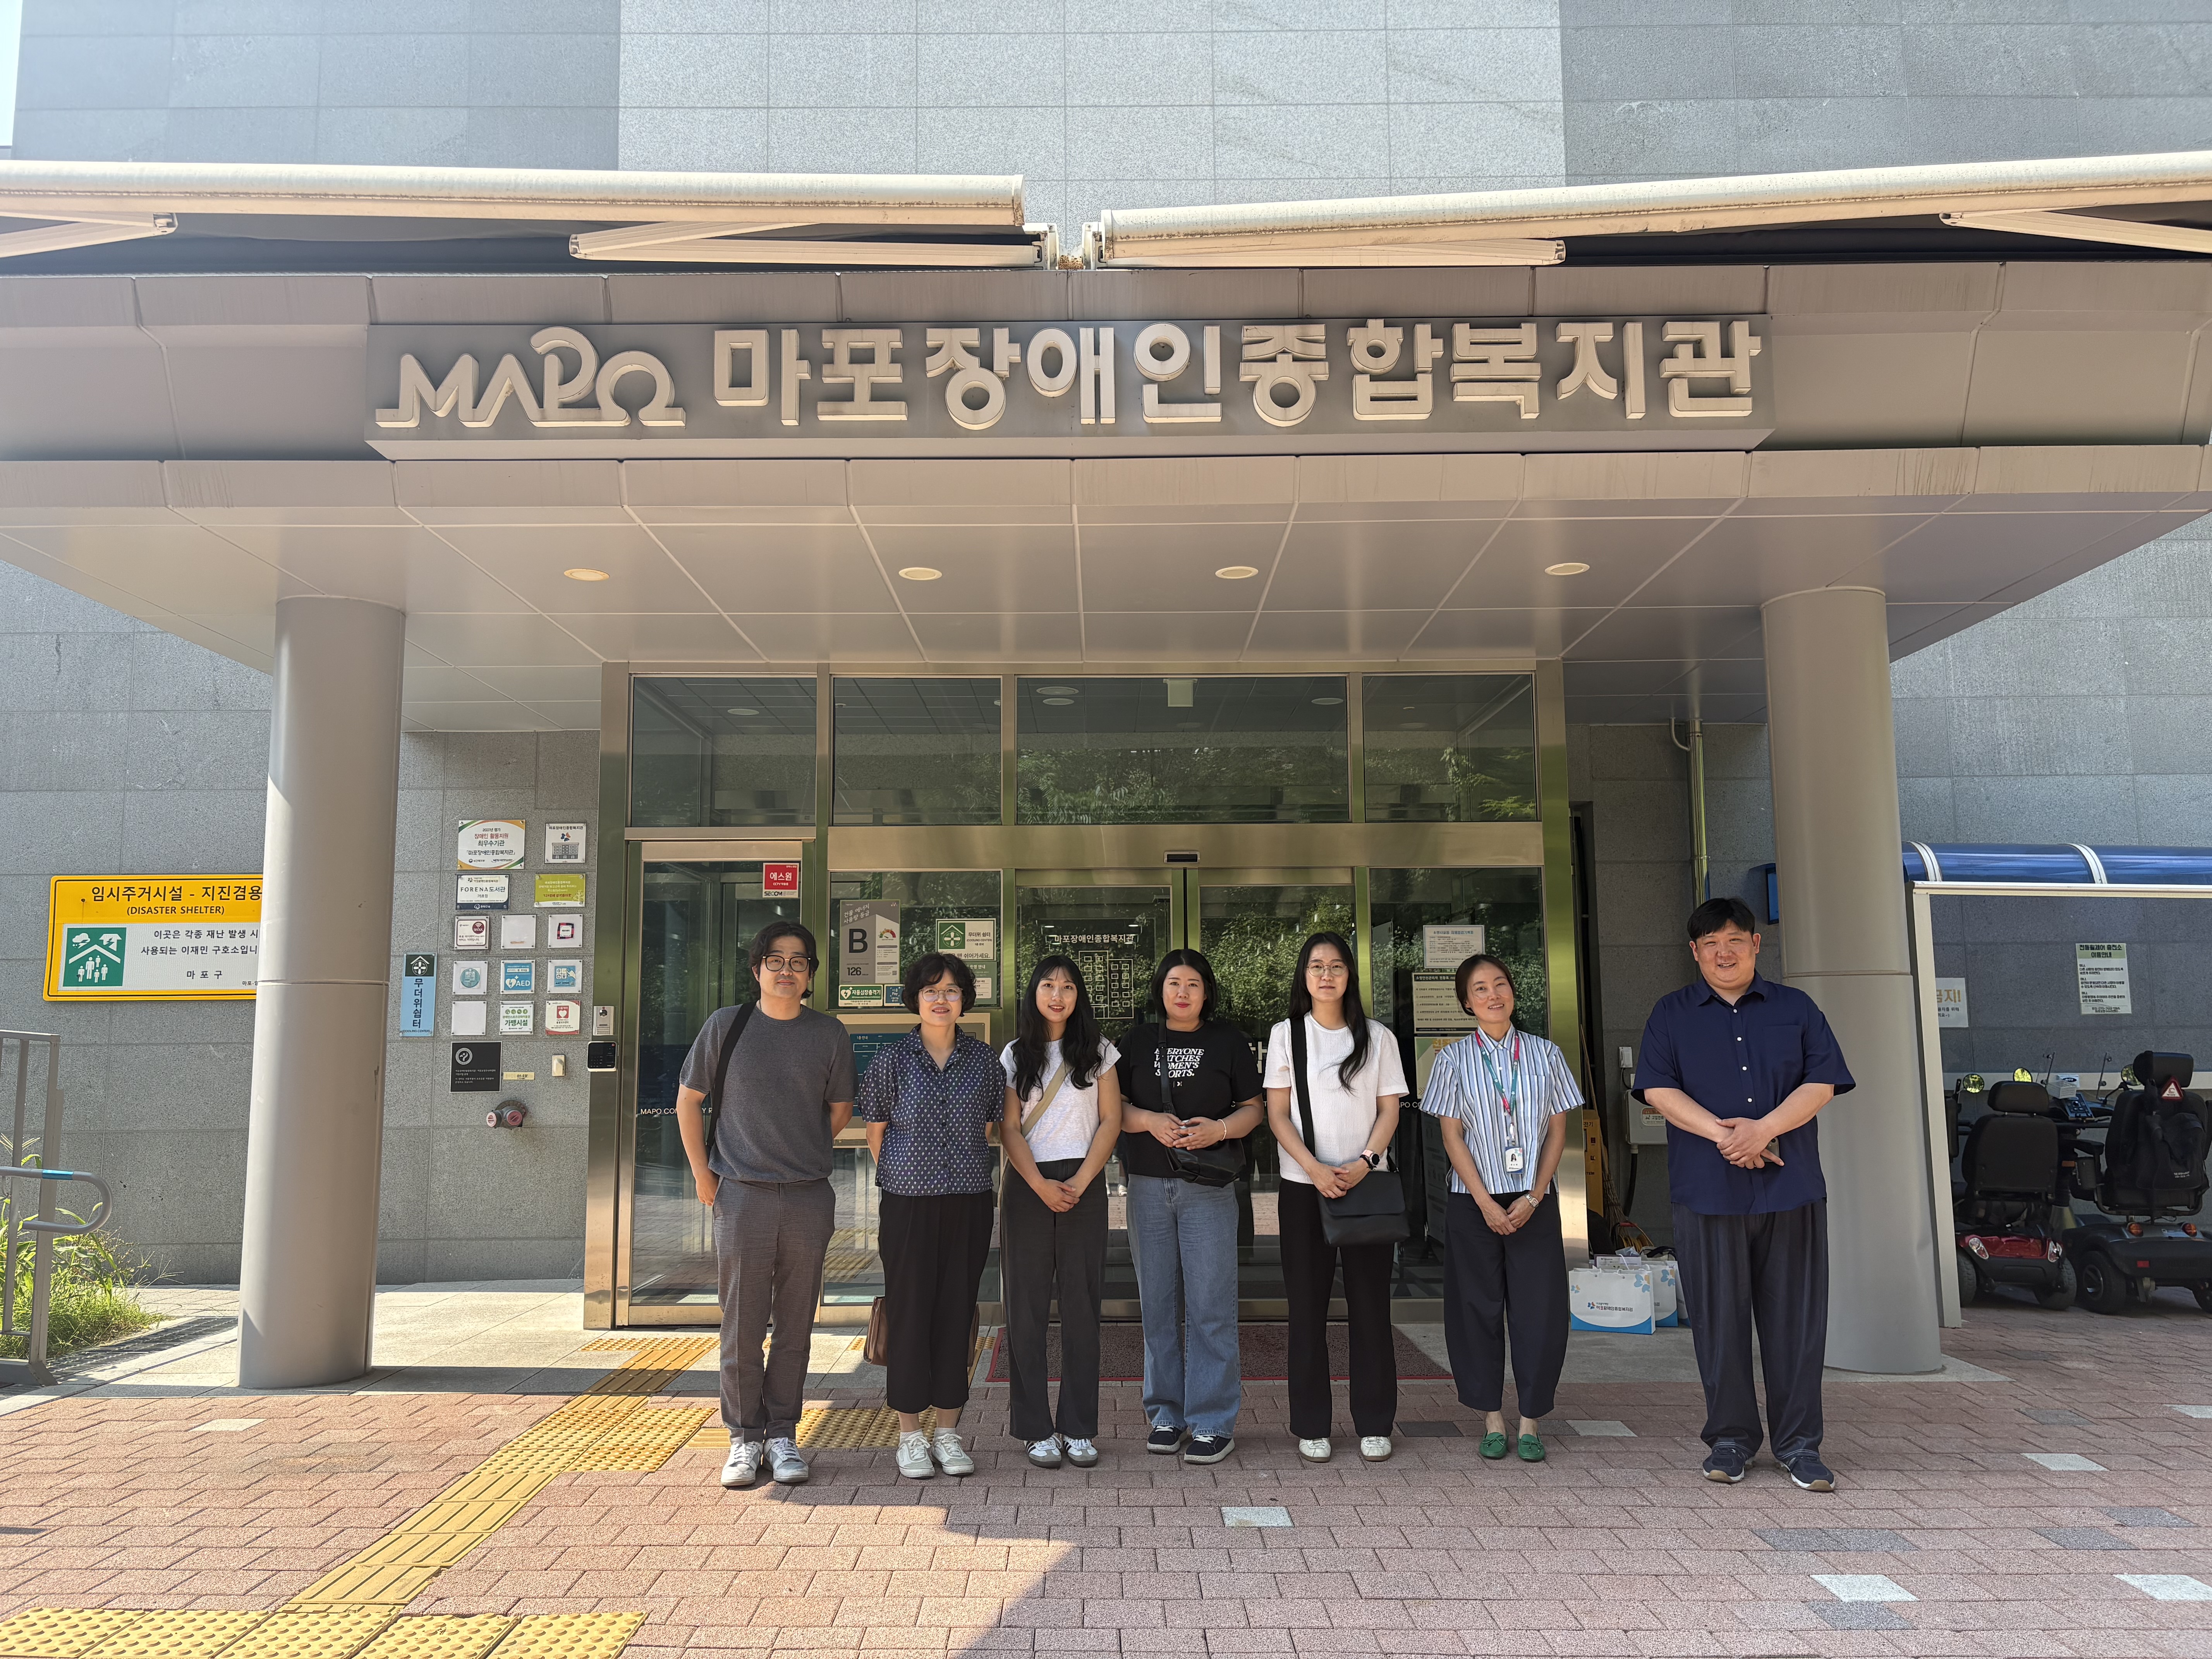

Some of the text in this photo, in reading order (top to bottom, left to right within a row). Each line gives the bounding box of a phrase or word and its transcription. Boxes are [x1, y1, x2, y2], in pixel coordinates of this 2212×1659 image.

[714, 319, 1762, 429] 마포장애인종합복지관
[770, 872, 792, 881] 에스원
[91, 885, 182, 902] 임시주거시설
[201, 884, 263, 902] 지진겸용
[127, 905, 225, 916] (DISASTER SHELTER)
[843, 903, 870, 918] 건물 에너지
[843, 910, 869, 924] 사용량 등급
[154, 929, 258, 939] 이곳은 각종 재난 발생 시
[1054, 934, 1134, 943] 마포장애인종합복지관
[849, 929, 868, 953] B
[141, 946, 177, 955] 사용되는
[181, 946, 208, 955] 이재민
[187, 970, 195, 979] 마
[214, 970, 223, 979] 구
[847, 967, 861, 976] 126
[412, 978, 423, 1028] 무더위쉼터
[1154, 1048, 1204, 1056] EERYONE
[1155, 1069, 1195, 1078] SORTS.
